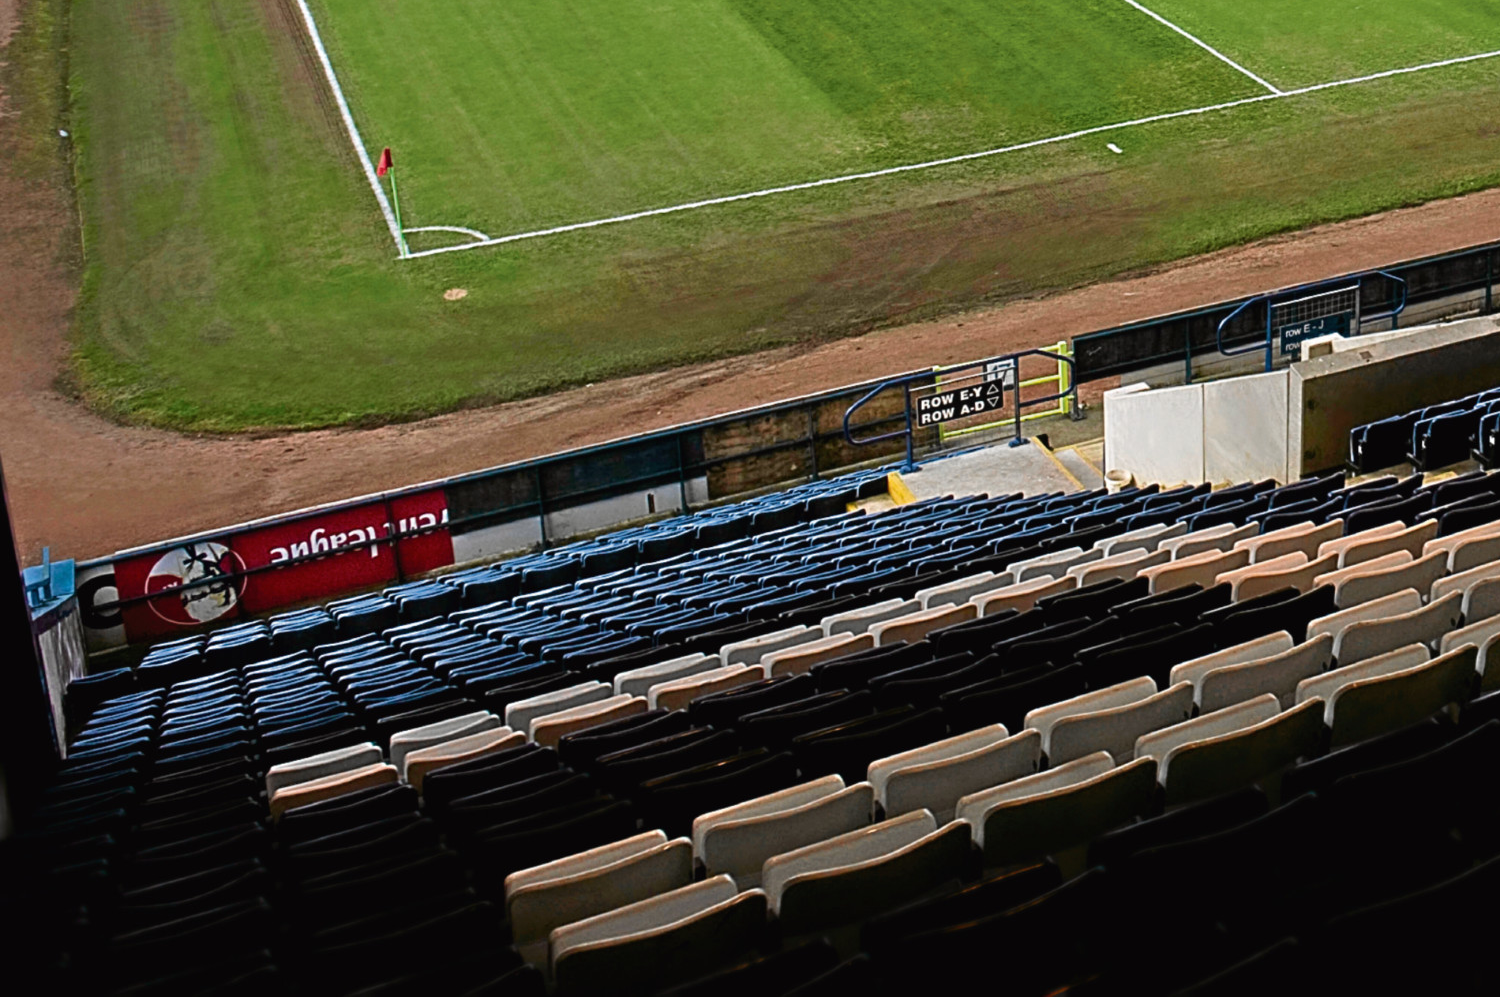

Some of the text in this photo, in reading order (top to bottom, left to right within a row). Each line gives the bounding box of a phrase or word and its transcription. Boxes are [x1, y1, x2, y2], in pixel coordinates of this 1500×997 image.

[1285, 327, 1302, 339] row
[992, 362, 1014, 383] 17
[920, 386, 983, 411] ROW E-Y
[921, 400, 986, 424] ROW A-D
[269, 525, 379, 564] league
